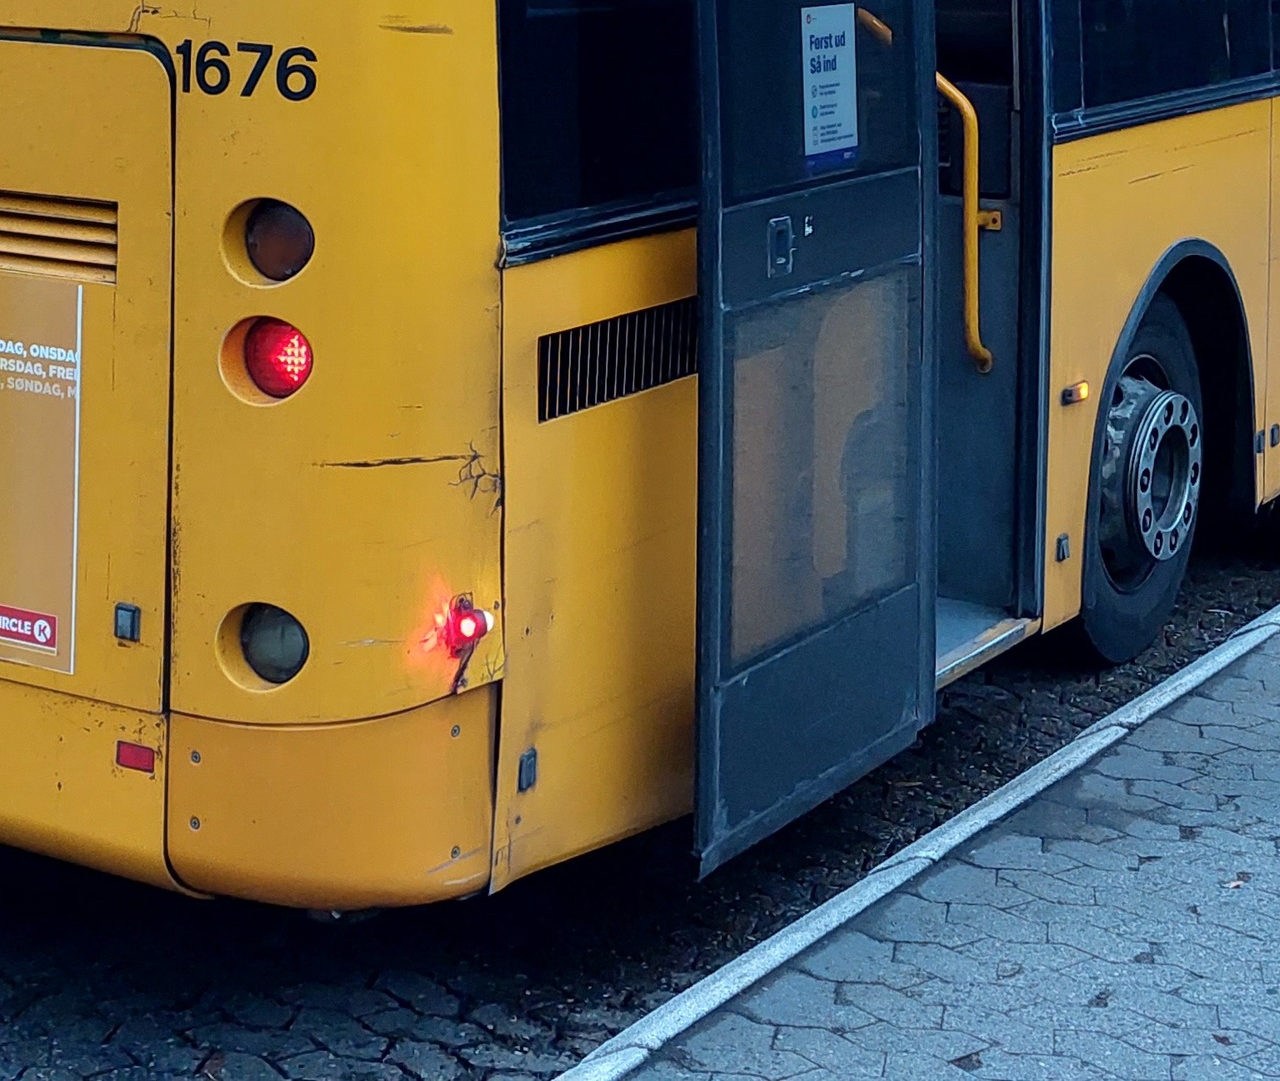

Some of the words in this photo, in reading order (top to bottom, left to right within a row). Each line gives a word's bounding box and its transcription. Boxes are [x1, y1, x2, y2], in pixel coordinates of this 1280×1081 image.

[810, 33, 833, 51] Først
[834, 31, 846, 47] ud
[176, 39, 318, 102] 1676
[810, 55, 822, 74] Så
[823, 55, 837, 72] ind
[7, 377, 64, 399] SØNDAG,
[36, 621, 50, 641] K
